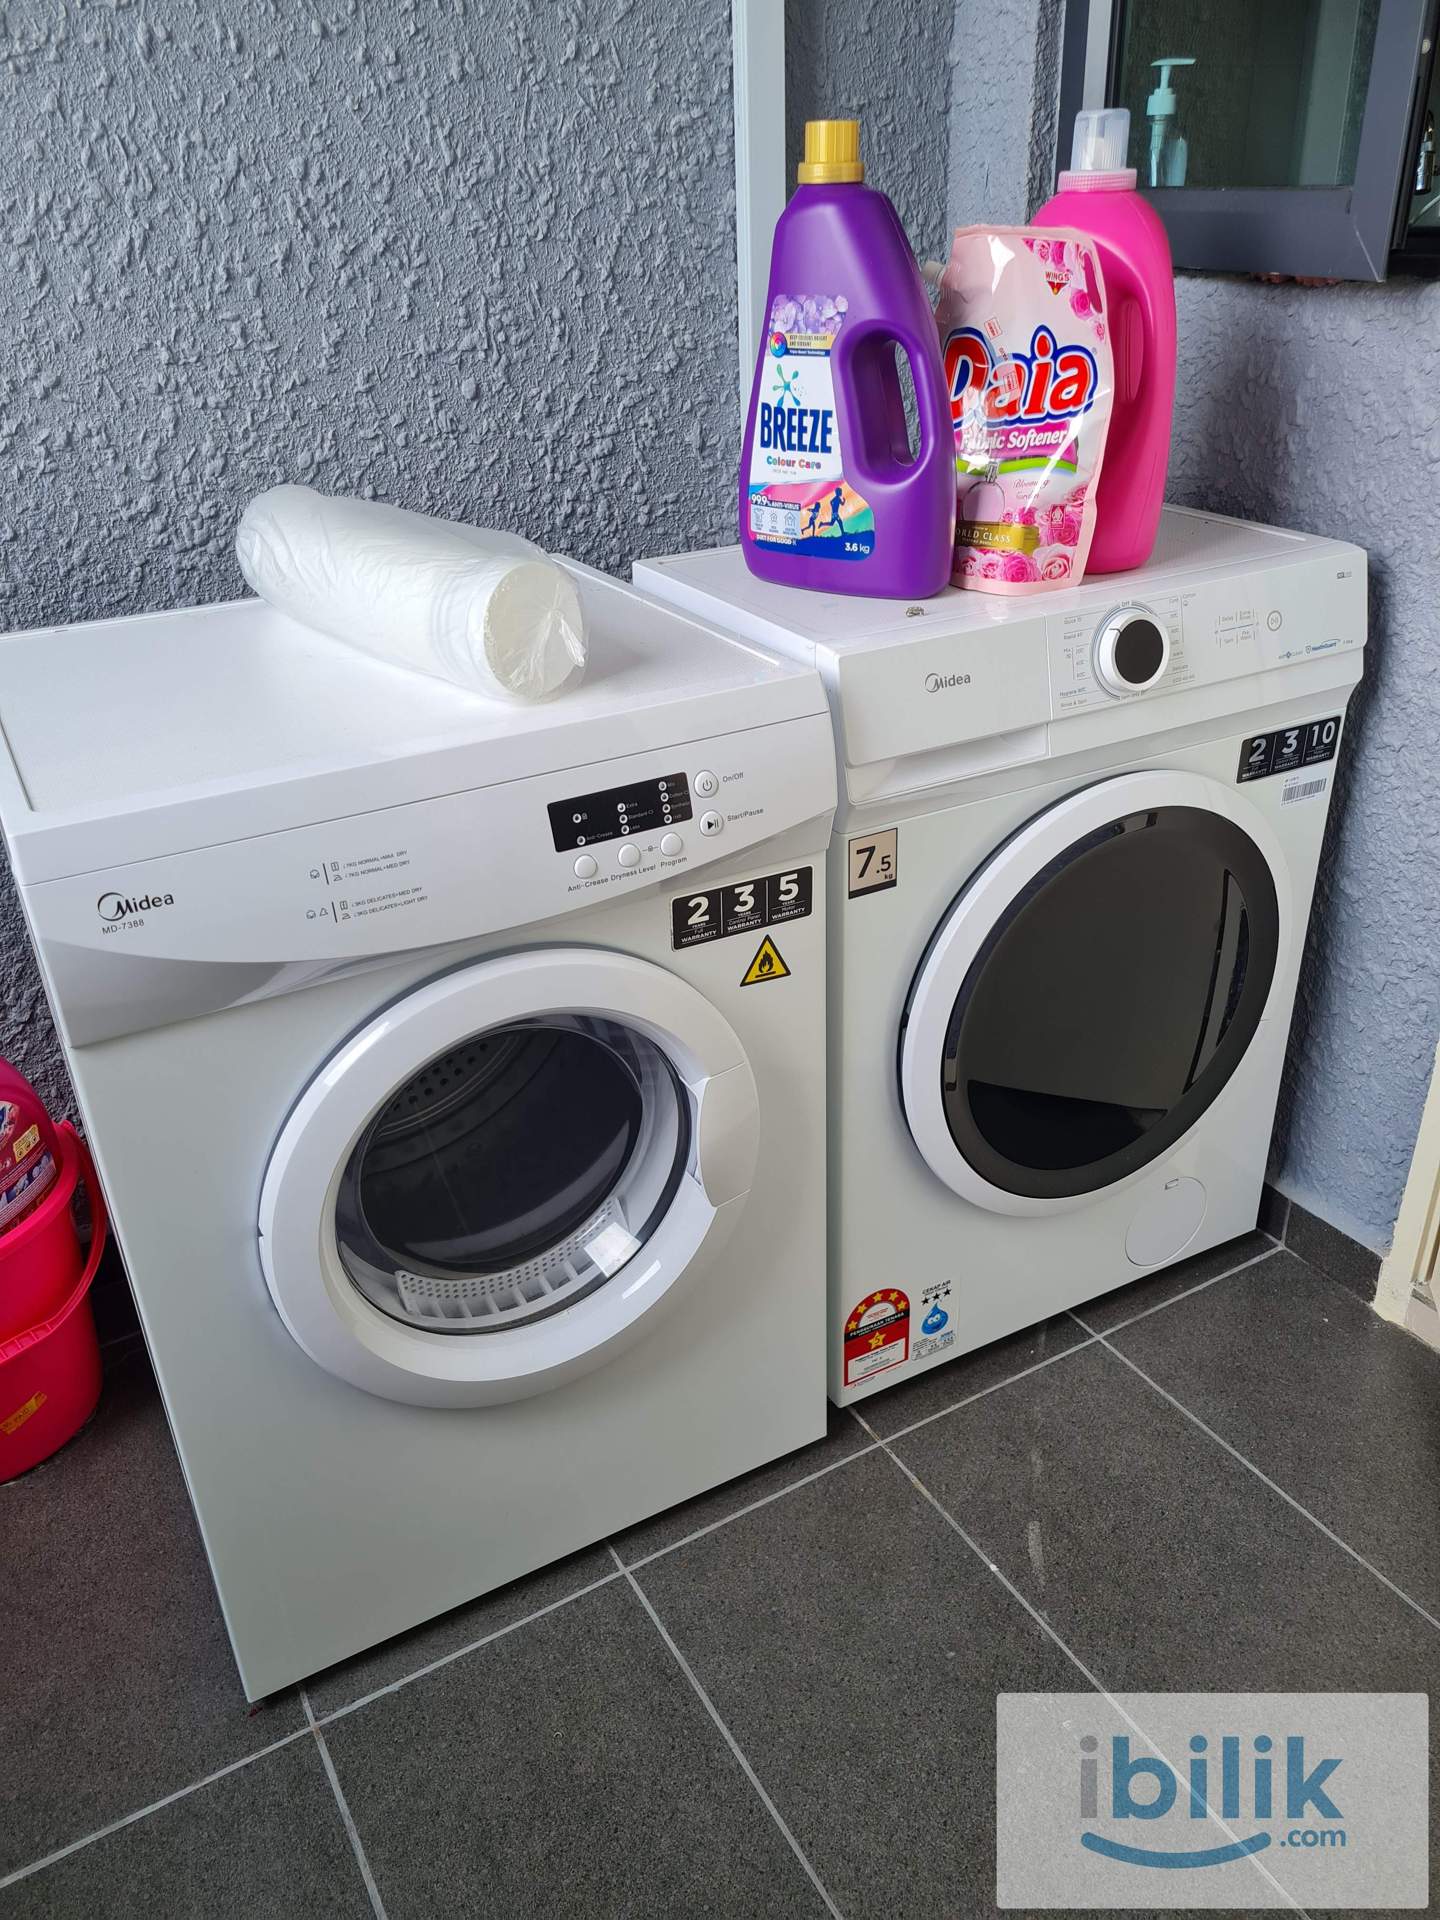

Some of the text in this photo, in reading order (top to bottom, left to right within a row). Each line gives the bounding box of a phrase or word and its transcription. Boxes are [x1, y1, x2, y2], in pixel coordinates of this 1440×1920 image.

[1045, 271, 1070, 282] WINGS
[943, 326, 1097, 424] Daia
[760, 402, 833, 454] BREEZE
[1006, 428, 1067, 452] Softener
[766, 455, 822, 470] Colour Care
[776, 536, 792, 545] GOOD
[982, 532, 1012, 543] CLASS
[844, 542, 870, 554] 3.6 kg
[924, 672, 972, 693] Midea
[1248, 738, 1267, 762] 2
[1282, 730, 1299, 754] 3
[1312, 720, 1336, 747] 10
[722, 772, 744, 784] On/Off
[727, 808, 764, 822] Start/Pause
[567, 856, 688, 893] Anti-Crease Dryness Level Program
[97, 892, 174, 922] Midea
[687, 873, 800, 926] 2 3 5
[771, 906, 806, 920] WARRANTY
[782, 904, 796, 912] Motor
[102, 918, 145, 935] MD-7388
[727, 918, 762, 932] WARRANTY
[728, 912, 761, 926] Control Panel
[681, 929, 718, 944] WARRANTY
